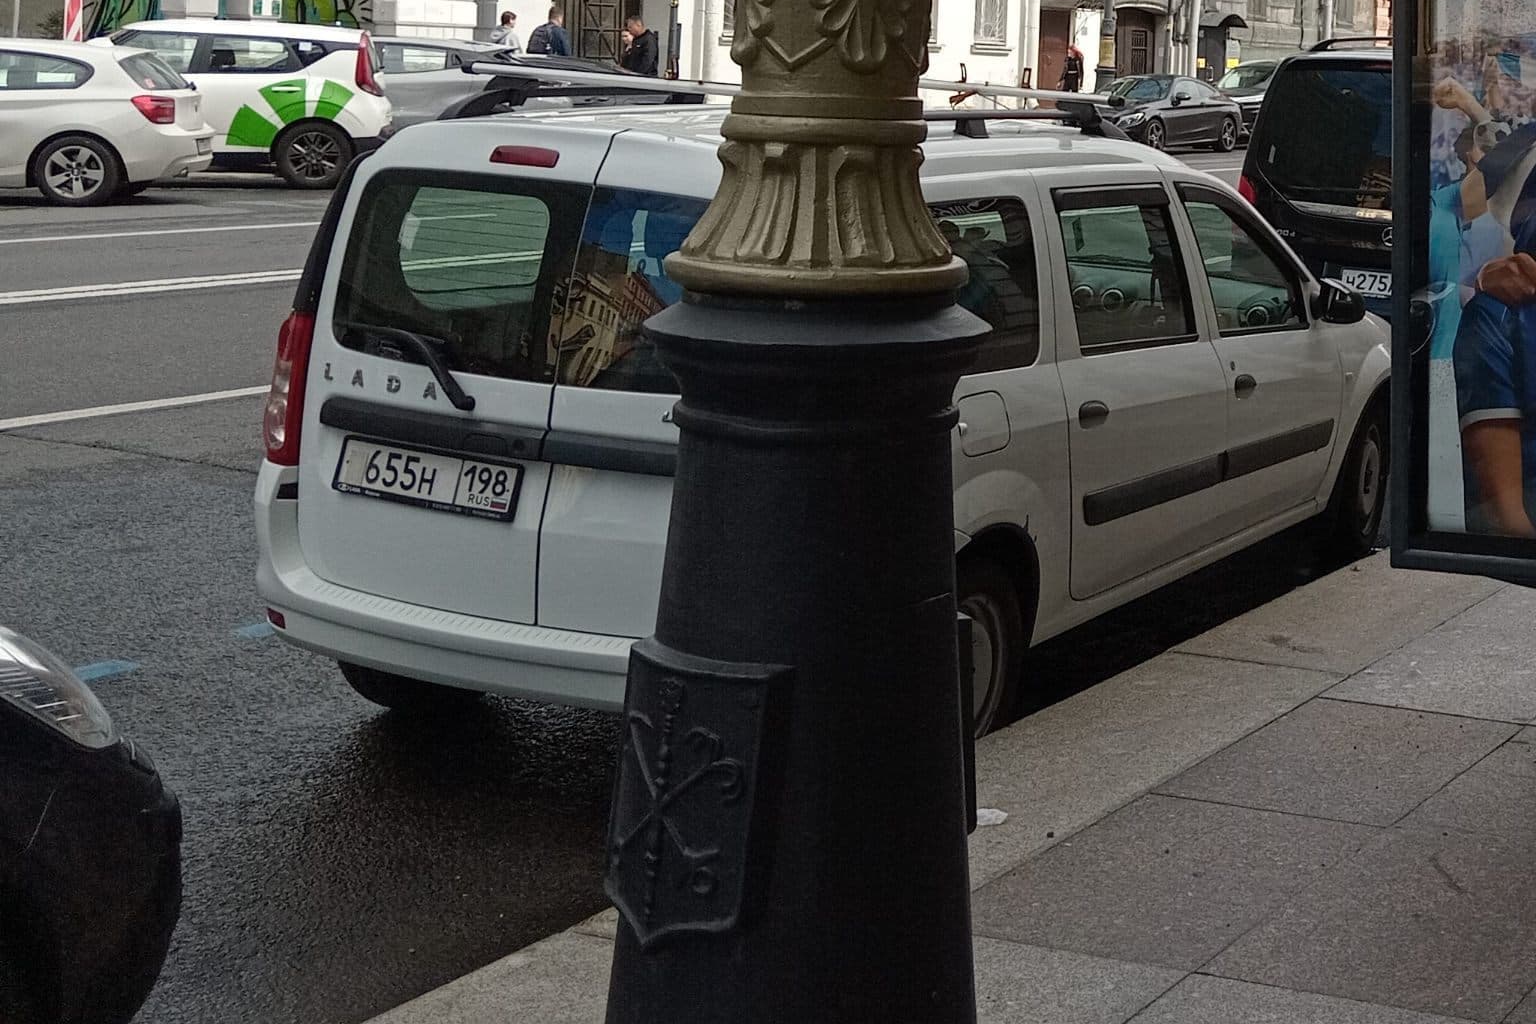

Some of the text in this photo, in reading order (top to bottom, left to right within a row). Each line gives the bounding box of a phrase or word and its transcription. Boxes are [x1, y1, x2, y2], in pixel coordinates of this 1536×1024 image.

[324, 363, 437, 400] LADA
[463, 465, 508, 497] 198
[467, 493, 490, 507] RUS
